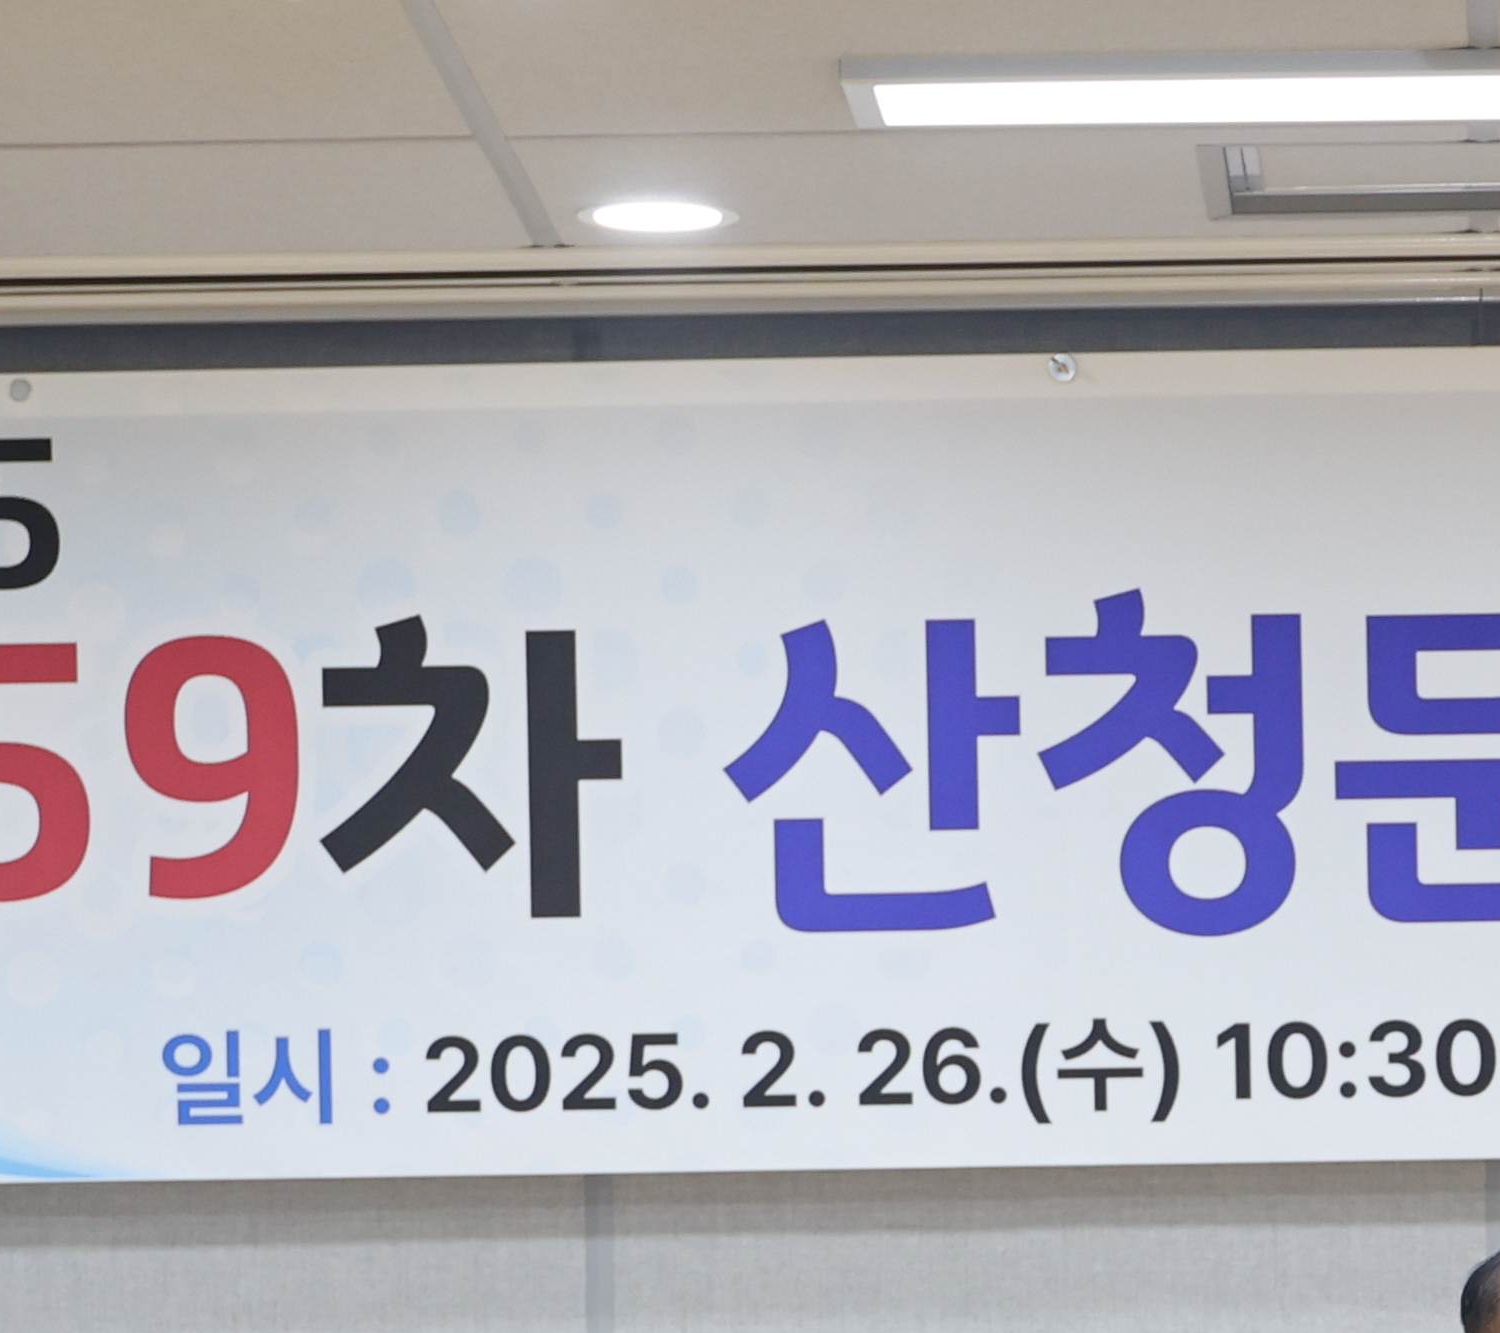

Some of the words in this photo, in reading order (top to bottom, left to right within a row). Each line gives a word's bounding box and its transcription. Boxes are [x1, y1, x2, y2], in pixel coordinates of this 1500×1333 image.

[424, 1033, 709, 1112] 2025.
[741, 1031, 826, 1107] 2.
[857, 1018, 1180, 1124] 26.(수)
[1216, 1019, 1497, 1100] 10:30
